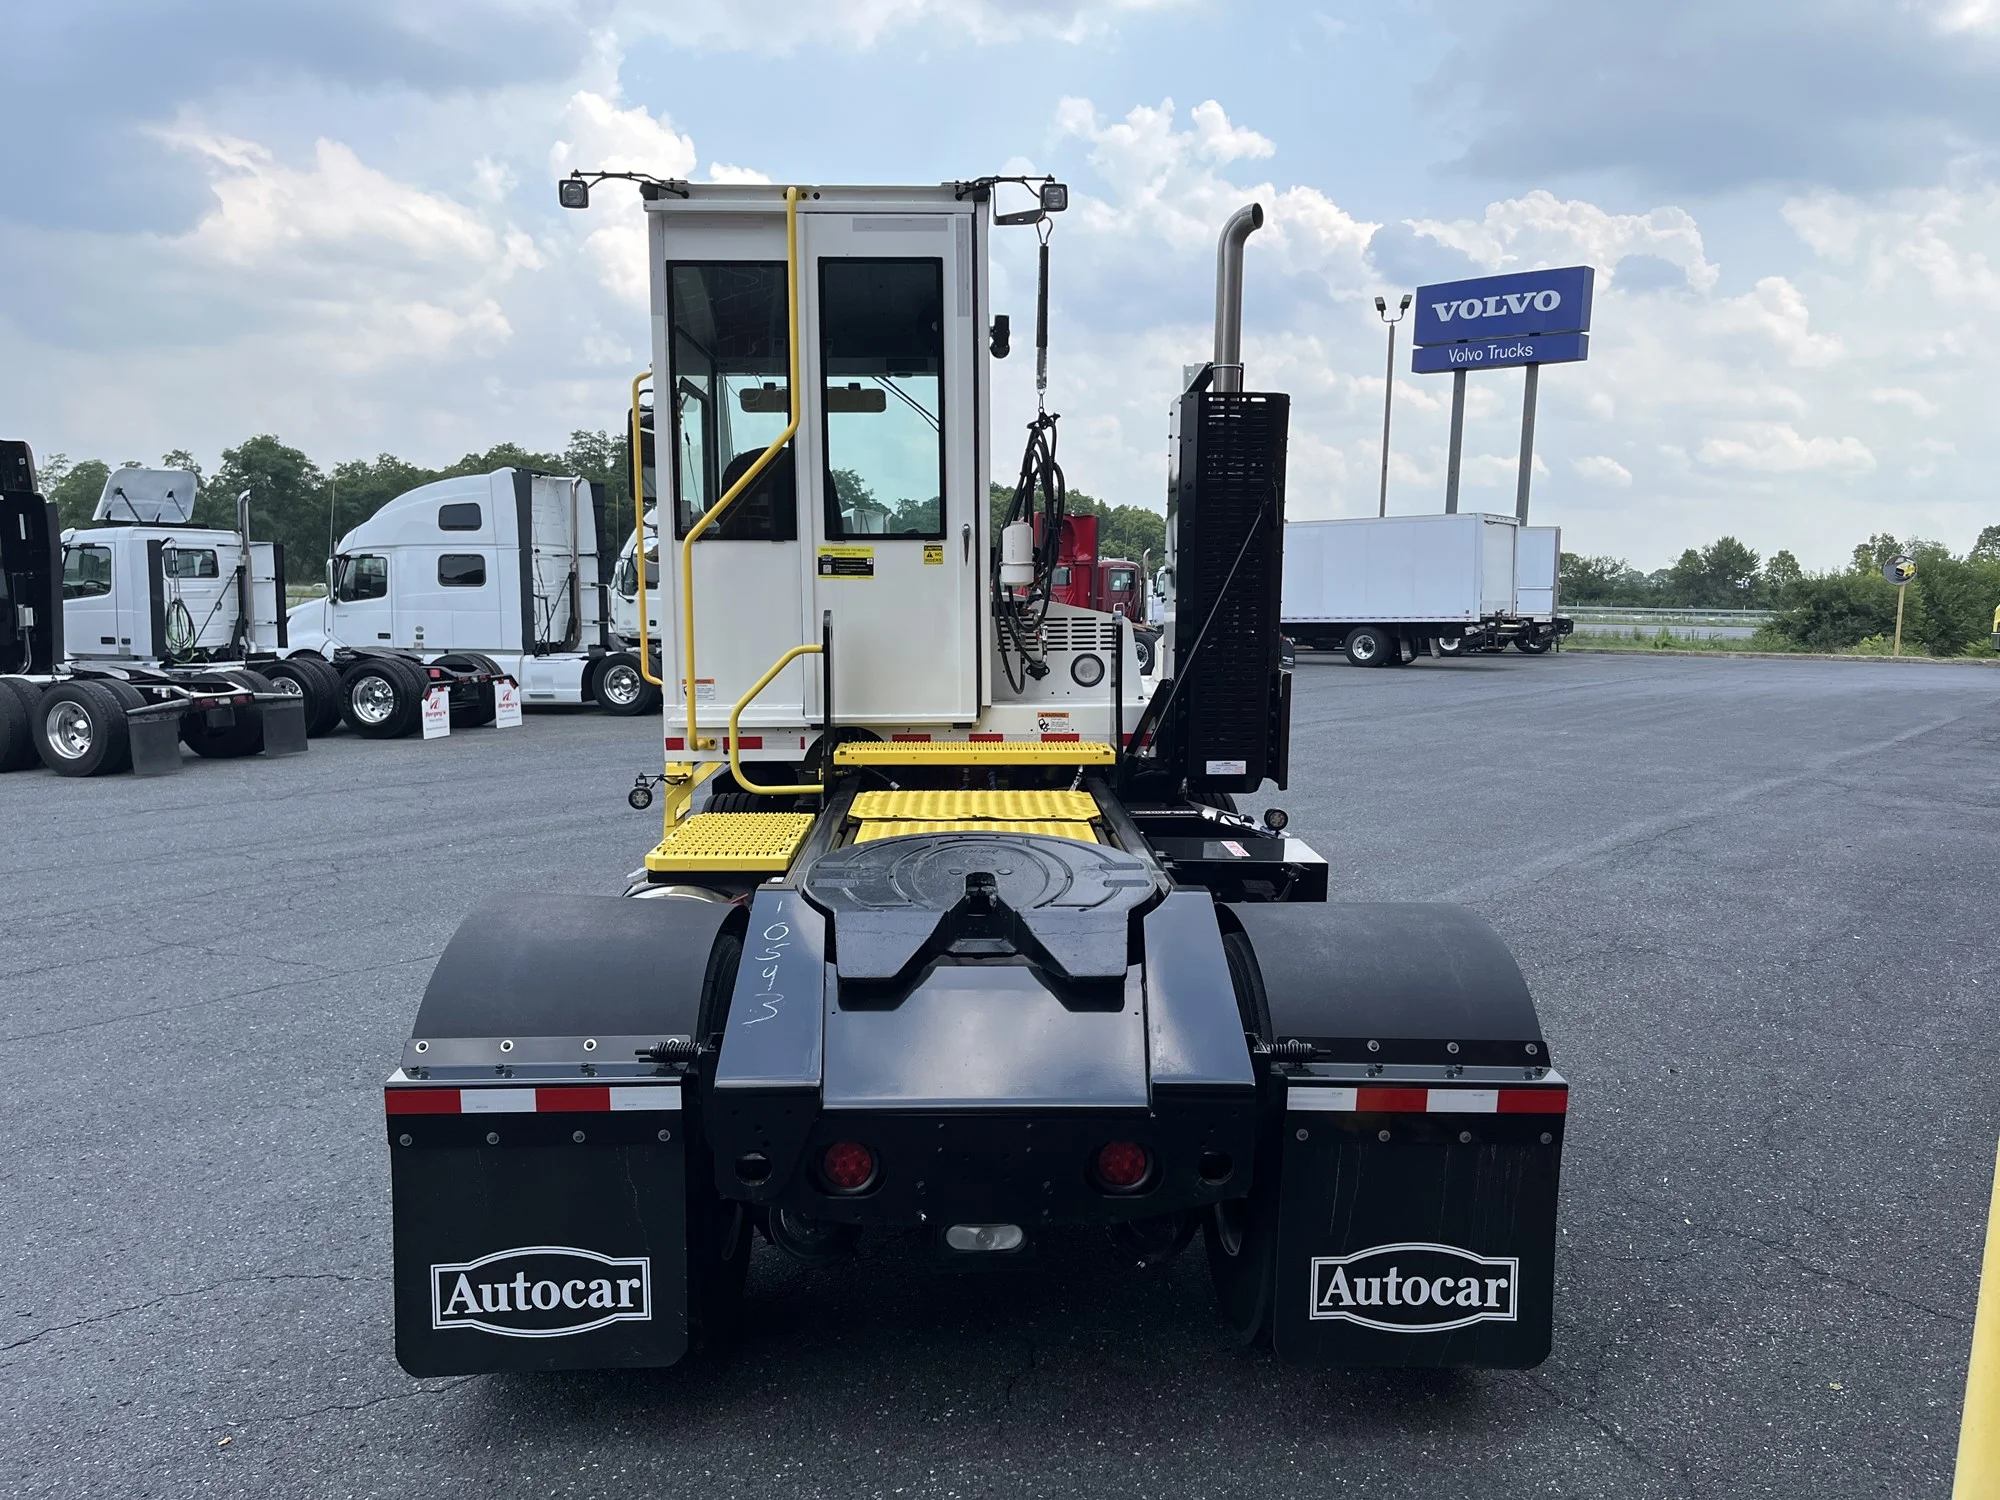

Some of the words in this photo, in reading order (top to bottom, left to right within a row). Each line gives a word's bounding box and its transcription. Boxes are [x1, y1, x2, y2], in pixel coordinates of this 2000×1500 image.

[1431, 289, 1562, 323] VOLVO
[1448, 346, 1484, 364] Volvo
[1487, 342, 1534, 360] Trucks
[442, 1271, 642, 1316] Autocar
[1318, 1265, 1509, 1308] Autocar
